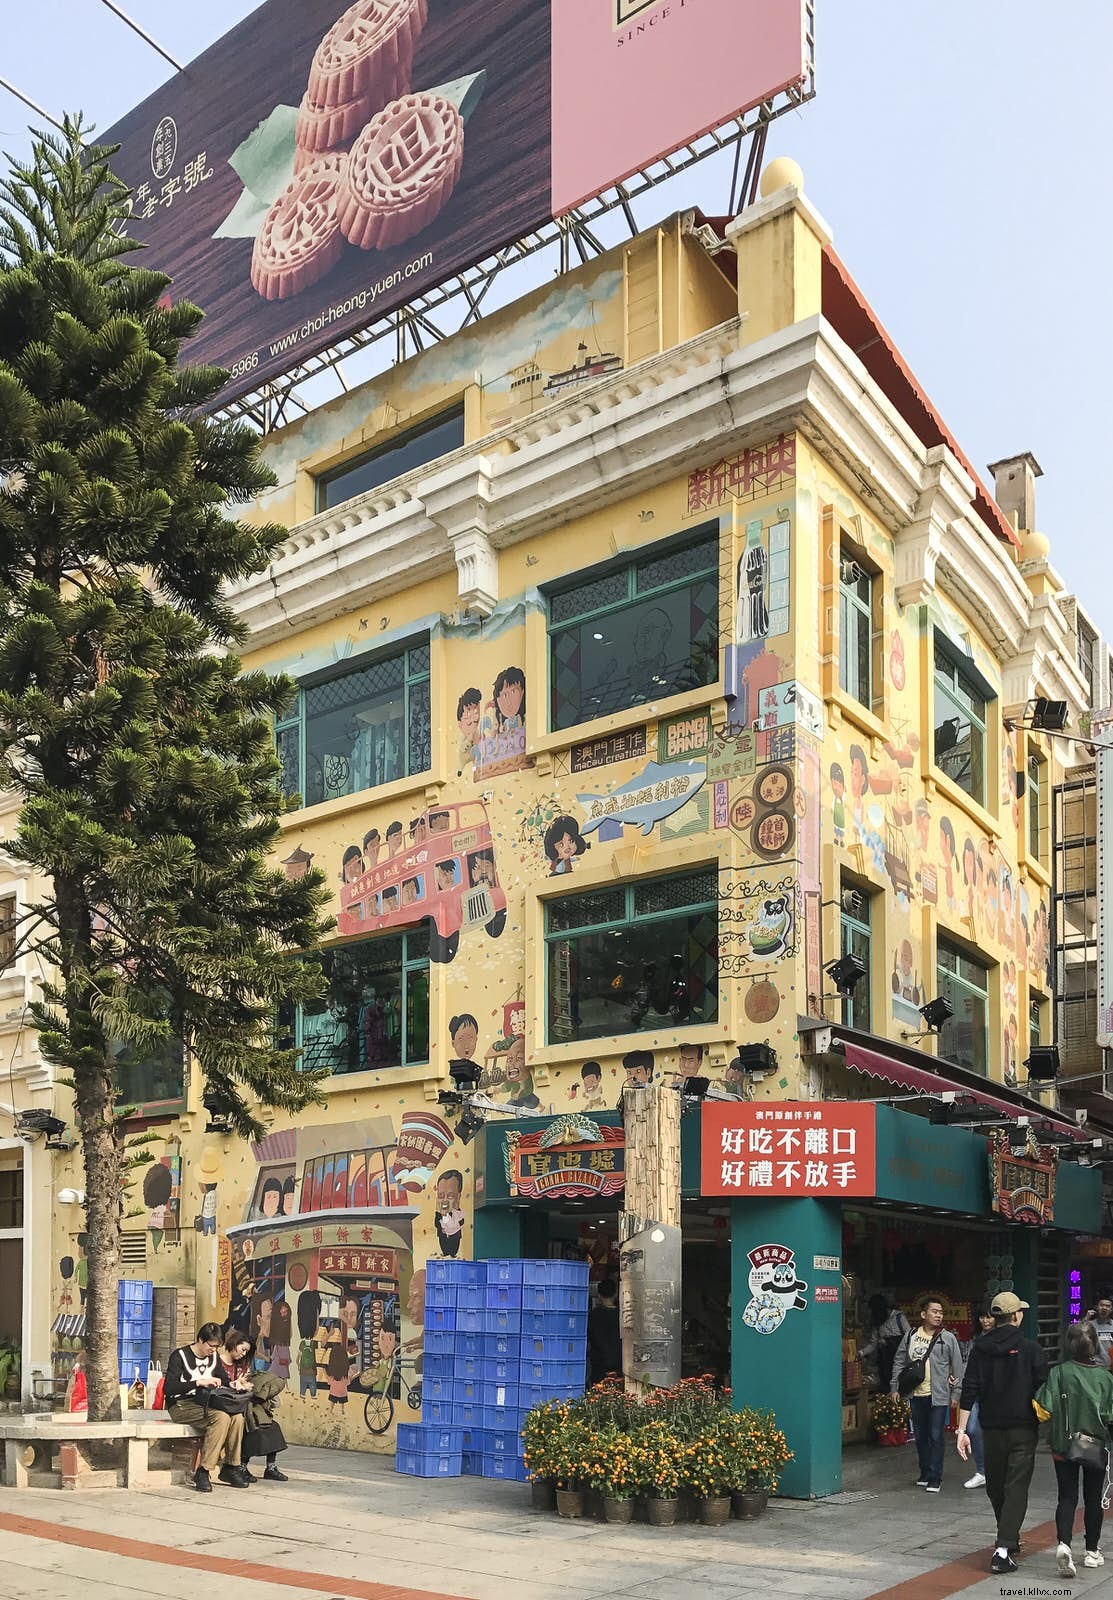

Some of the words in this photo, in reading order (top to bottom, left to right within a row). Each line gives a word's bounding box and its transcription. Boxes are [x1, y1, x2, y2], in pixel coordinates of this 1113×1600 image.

[617, 7, 670, 48] SINCE
[270, 251, 433, 356] www.choi-heong-yuen.com
[689, 433, 797, 510] 新中央
[575, 758, 603, 771] macau
[606, 747, 646, 764] creations
[577, 732, 643, 761] 澳門佳作
[720, 1127, 857, 1155] 好吃不離口
[720, 1160, 857, 1188] 好禮不放手
[324, 1256, 390, 1272] 咀香園餅家
